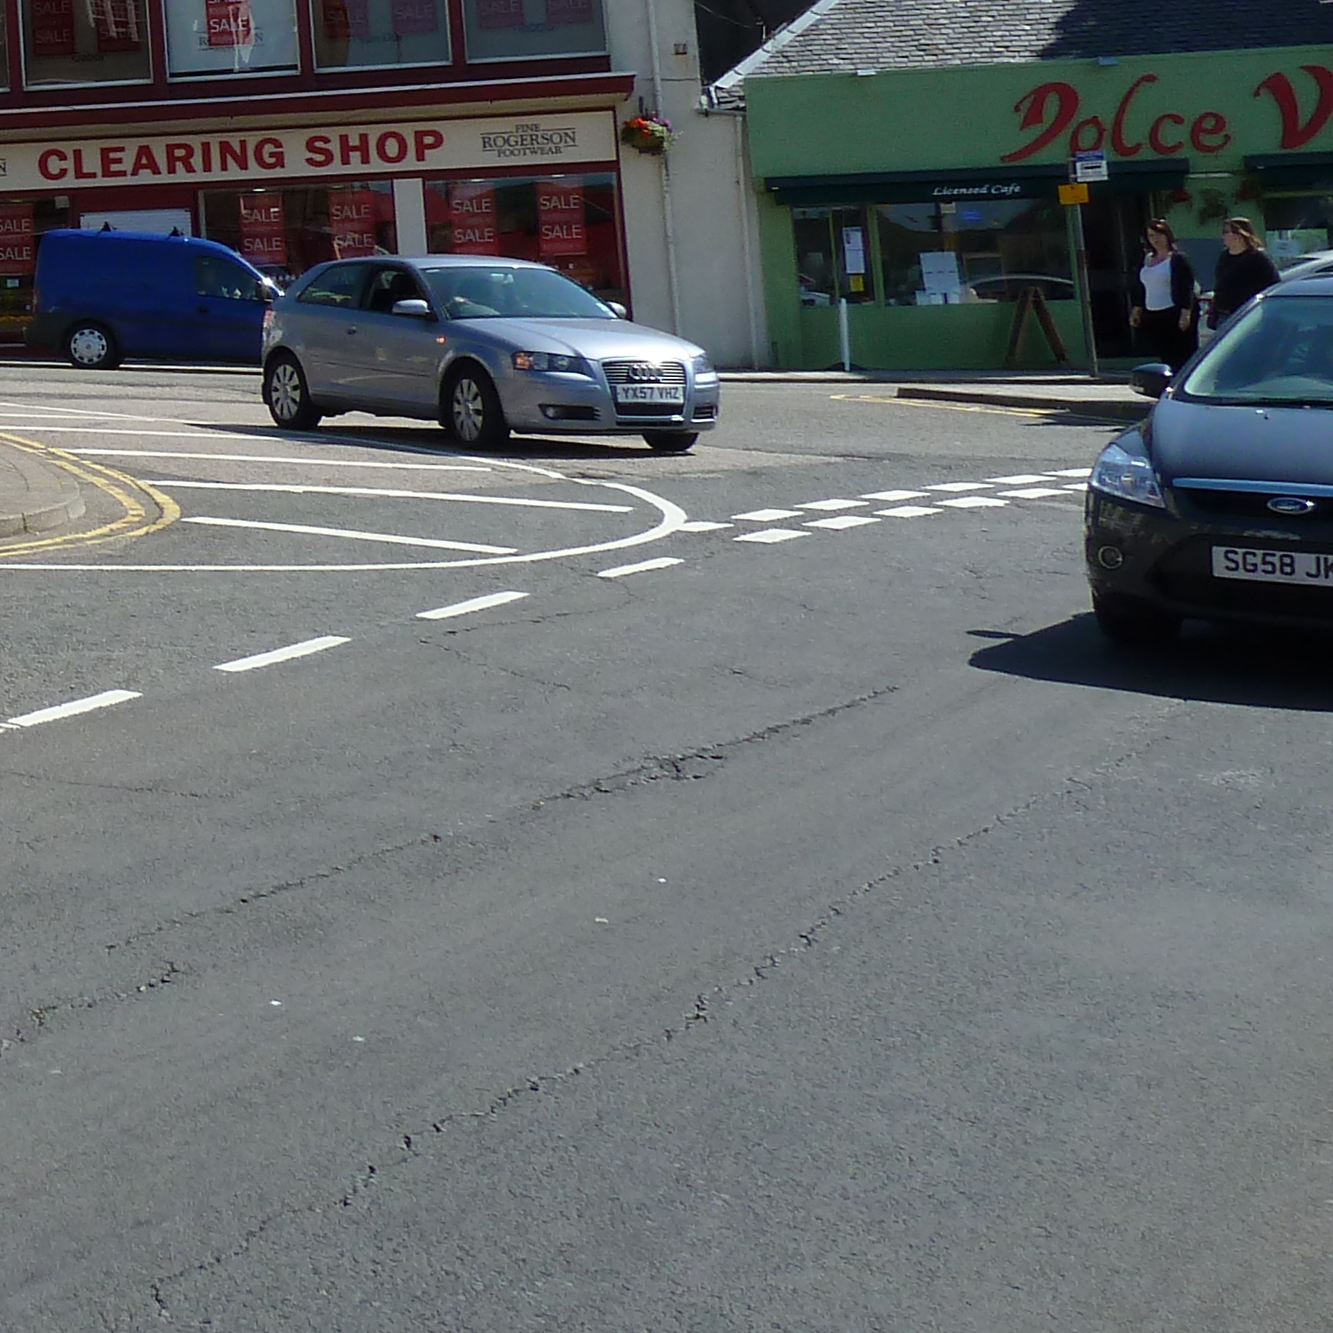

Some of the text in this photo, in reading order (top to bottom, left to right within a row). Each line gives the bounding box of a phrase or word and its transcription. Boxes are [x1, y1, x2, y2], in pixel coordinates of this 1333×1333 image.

[35, 0, 70, 15] SALE
[209, 16, 249, 33] SALE
[1000, 73, 1232, 163] Dolce
[515, 123, 541, 133] FINE
[482, 130, 576, 150] ROGERSON
[37, 129, 445, 181] CLEARING SHOP
[496, 145, 563, 158] FOOTWEAR
[991, 183, 1021, 196] Cafe
[452, 199, 492, 215] SALE
[539, 195, 580, 210] SALE
[242, 209, 281, 224] SALE
[333, 204, 371, 220] SALE
[454, 228, 495, 244] SALE
[541, 224, 583, 240] SALE
[243, 237, 283, 252] SALE
[622, 386, 680, 399] YX57 VHZ
[1224, 550, 1296, 576] SG58
